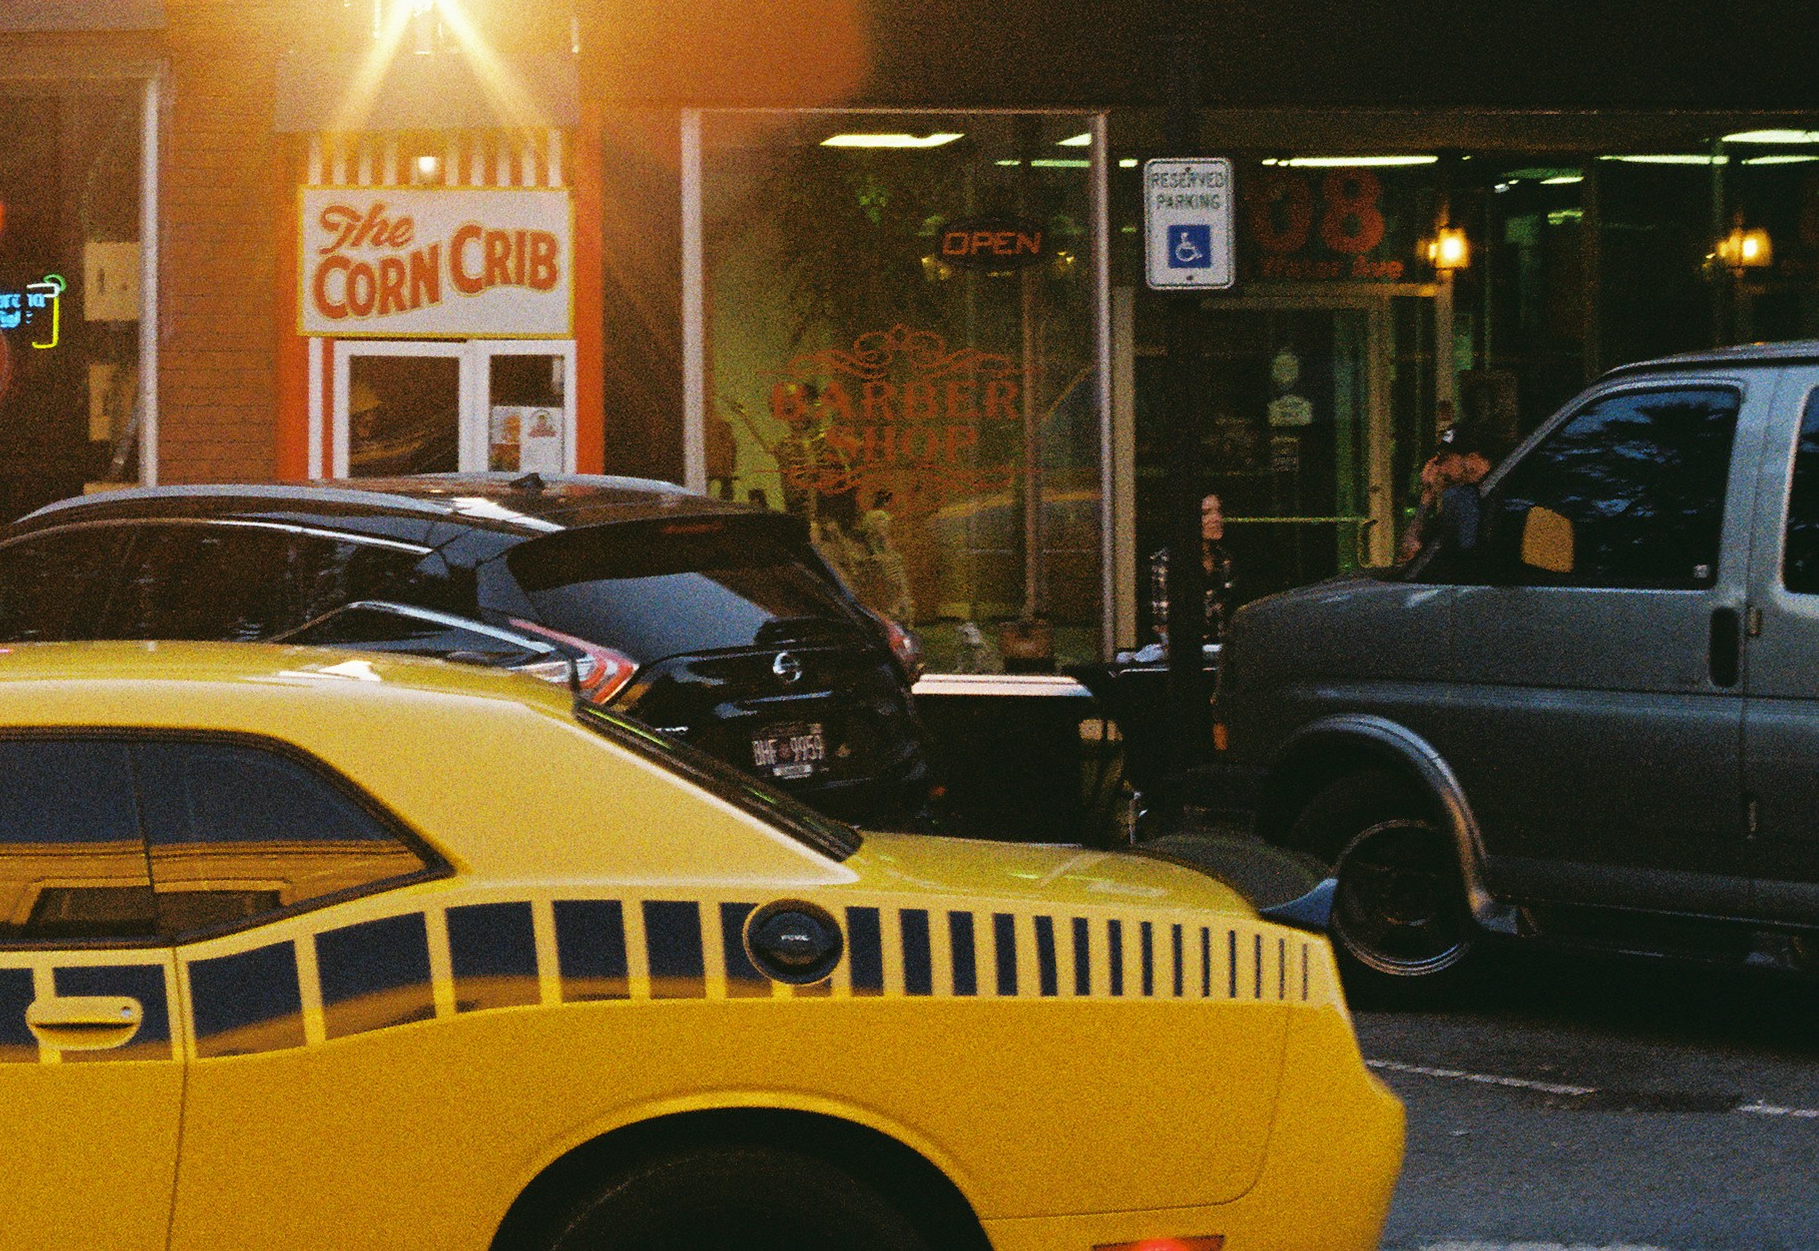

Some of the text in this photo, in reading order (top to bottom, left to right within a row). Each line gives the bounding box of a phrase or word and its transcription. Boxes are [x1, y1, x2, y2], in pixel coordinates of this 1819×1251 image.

[1150, 171, 1225, 189] RESERVED
[1156, 194, 1222, 211] PARKING
[319, 202, 415, 255] The
[942, 231, 1042, 256] OPEN
[312, 223, 560, 320] CORN CRIB
[1351, 254, 1405, 279] Ave
[770, 379, 1020, 420] BARBER
[823, 424, 979, 463] SHOP
